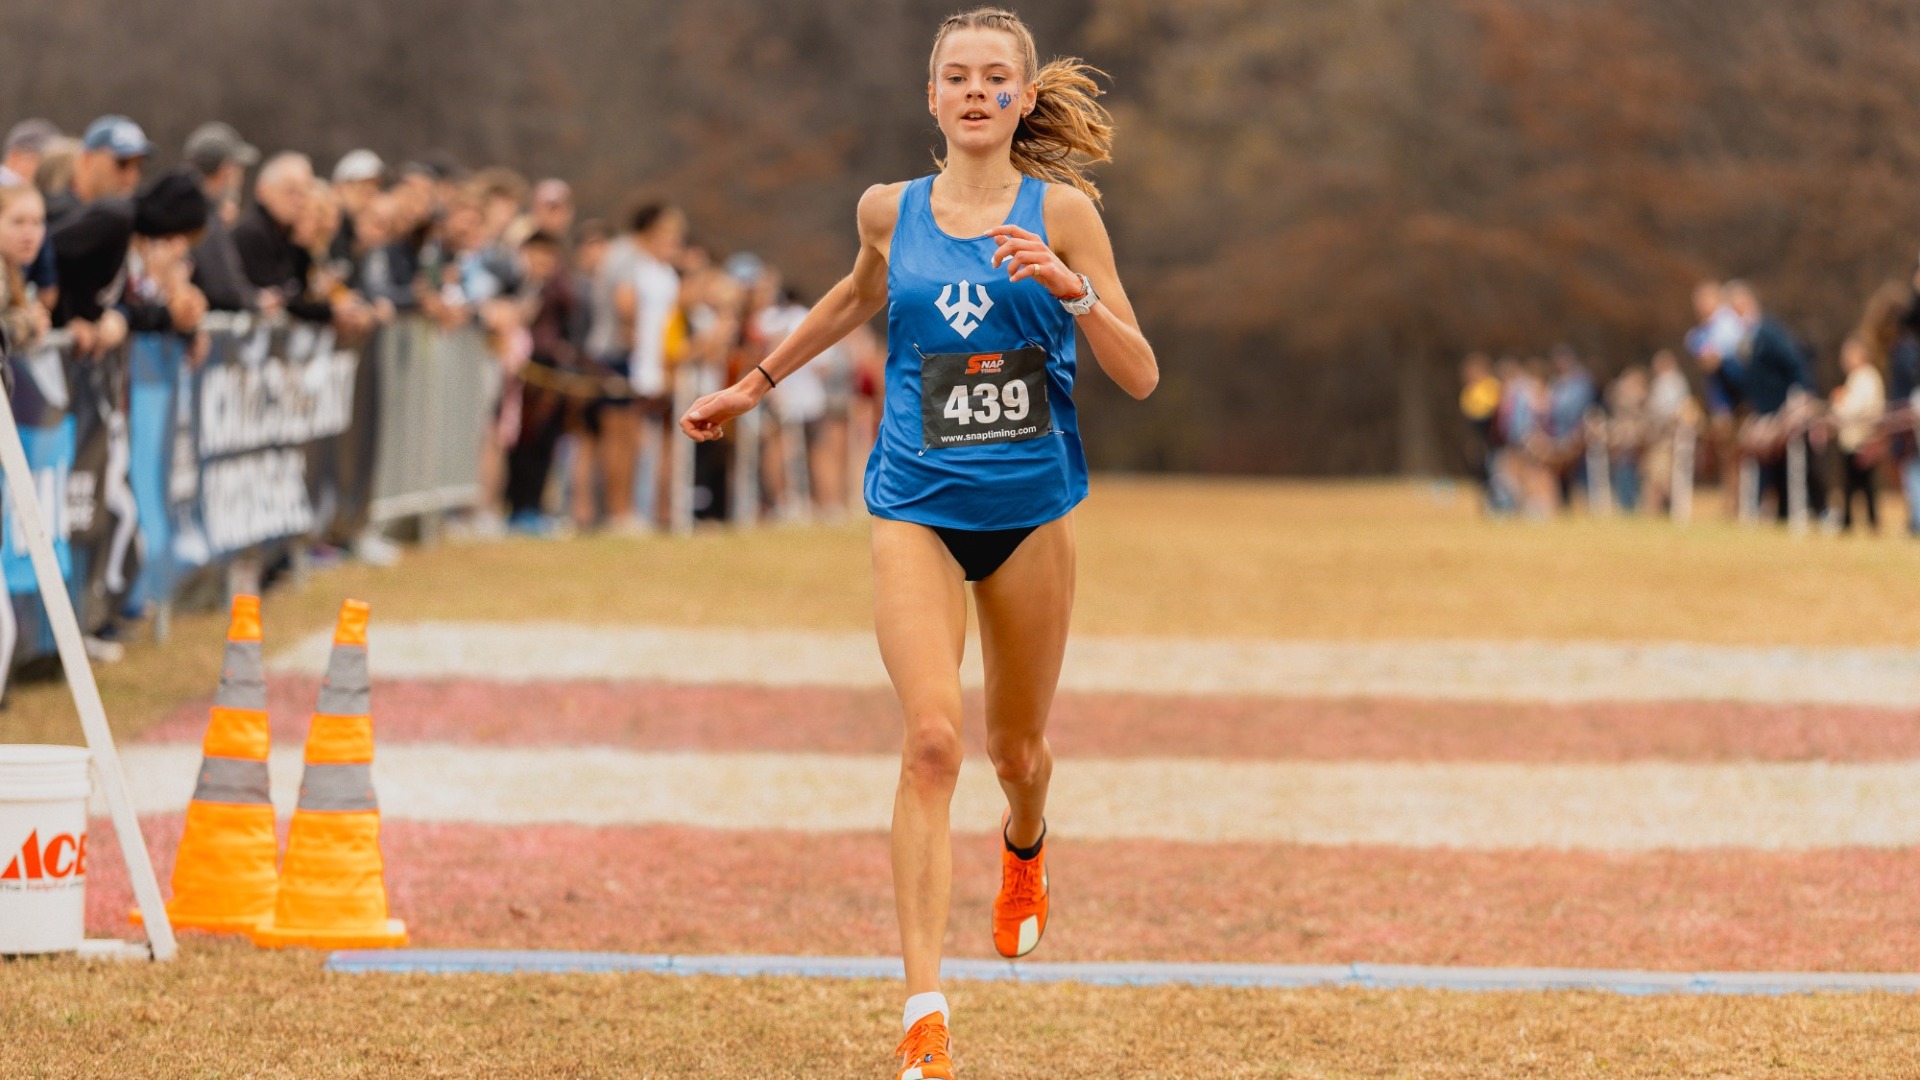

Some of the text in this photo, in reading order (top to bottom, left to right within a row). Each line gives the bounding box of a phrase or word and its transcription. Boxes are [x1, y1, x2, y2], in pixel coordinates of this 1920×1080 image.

[965, 353, 1004, 374] SNAP
[943, 379, 1030, 425] 439
[941, 425, 1037, 443] www.snaptiming.com
